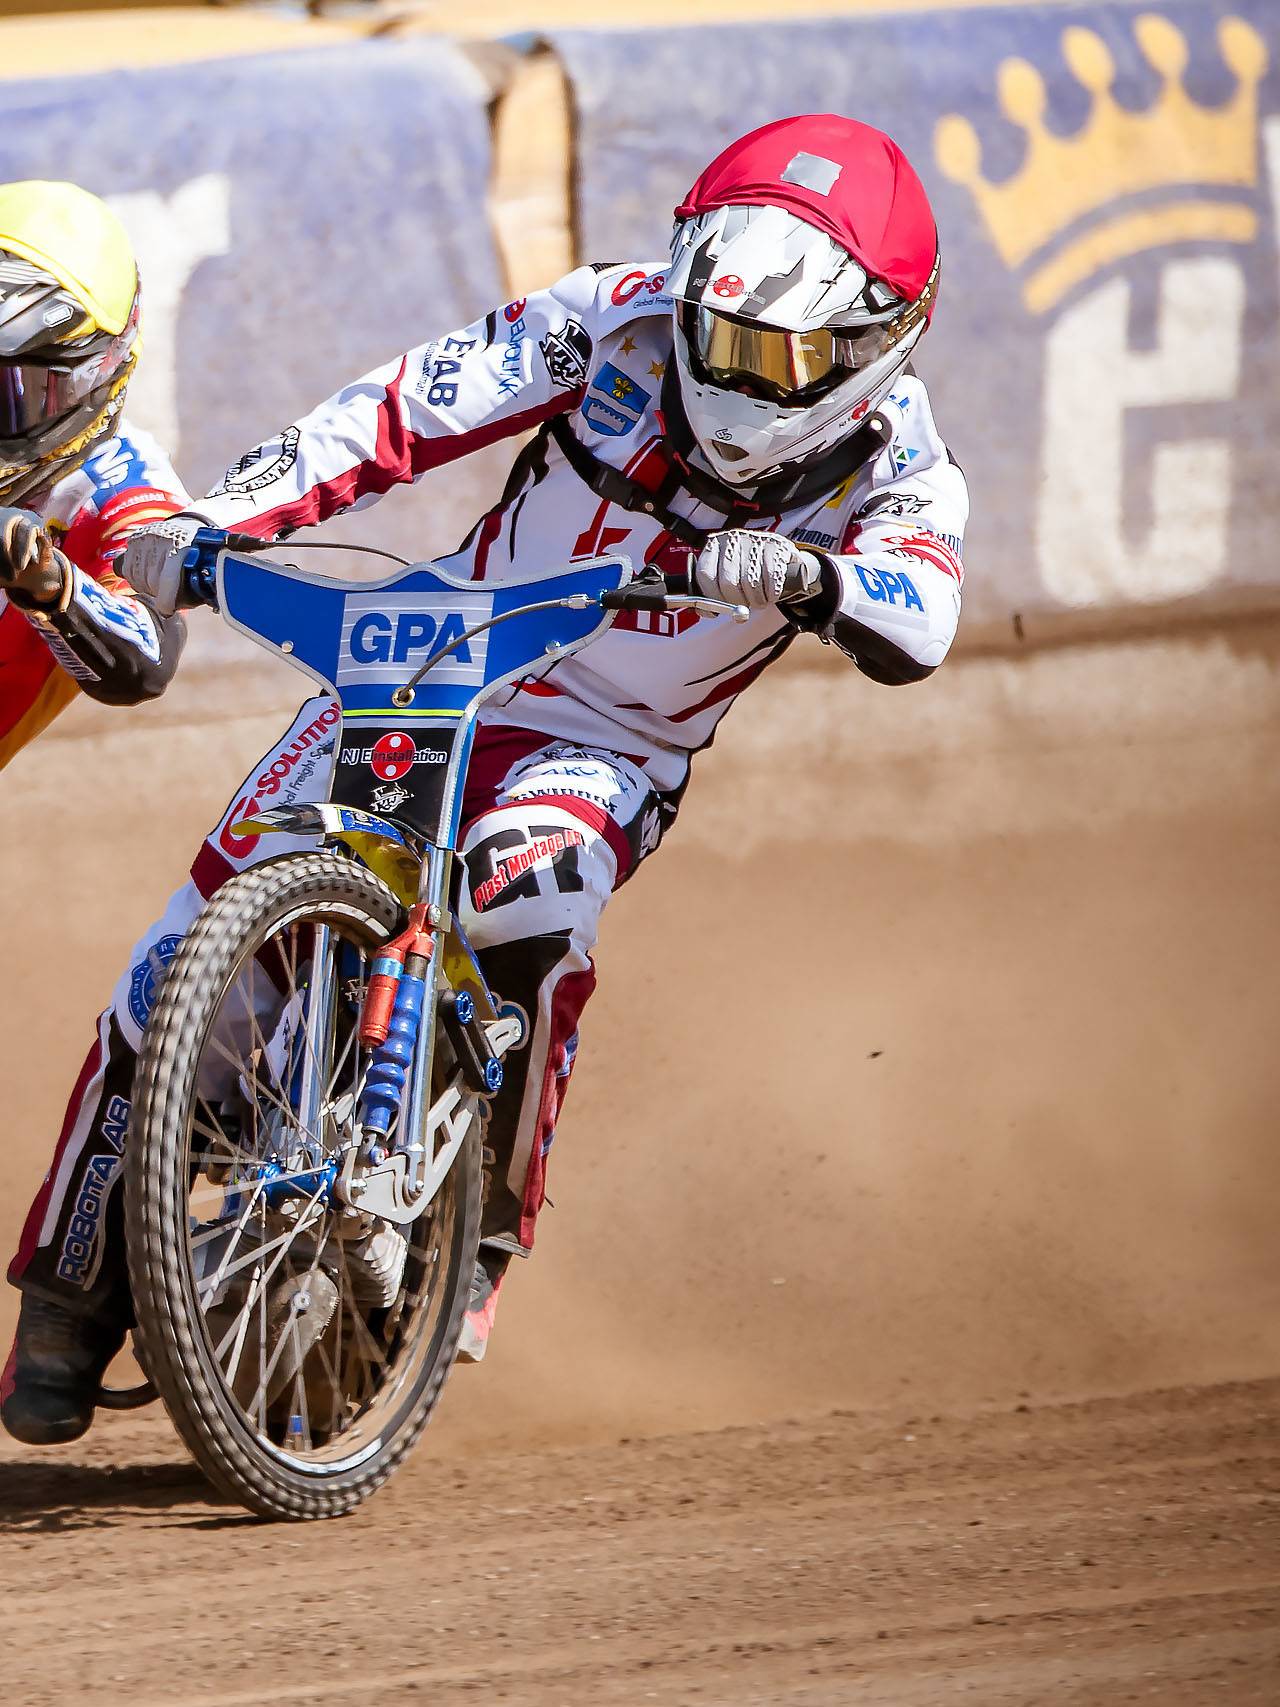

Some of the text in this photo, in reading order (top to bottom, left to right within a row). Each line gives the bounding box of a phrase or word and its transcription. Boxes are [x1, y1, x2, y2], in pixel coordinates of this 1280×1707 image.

[854, 563, 925, 613] GPA
[349, 612, 473, 664] GPA
[220, 702, 342, 860] G-SOLUTIO
[340, 748, 361, 766] NJ
[473, 867, 510, 913] Plast
[506, 832, 565, 884] Montage
[57, 1154, 120, 1285] ROBOTA
